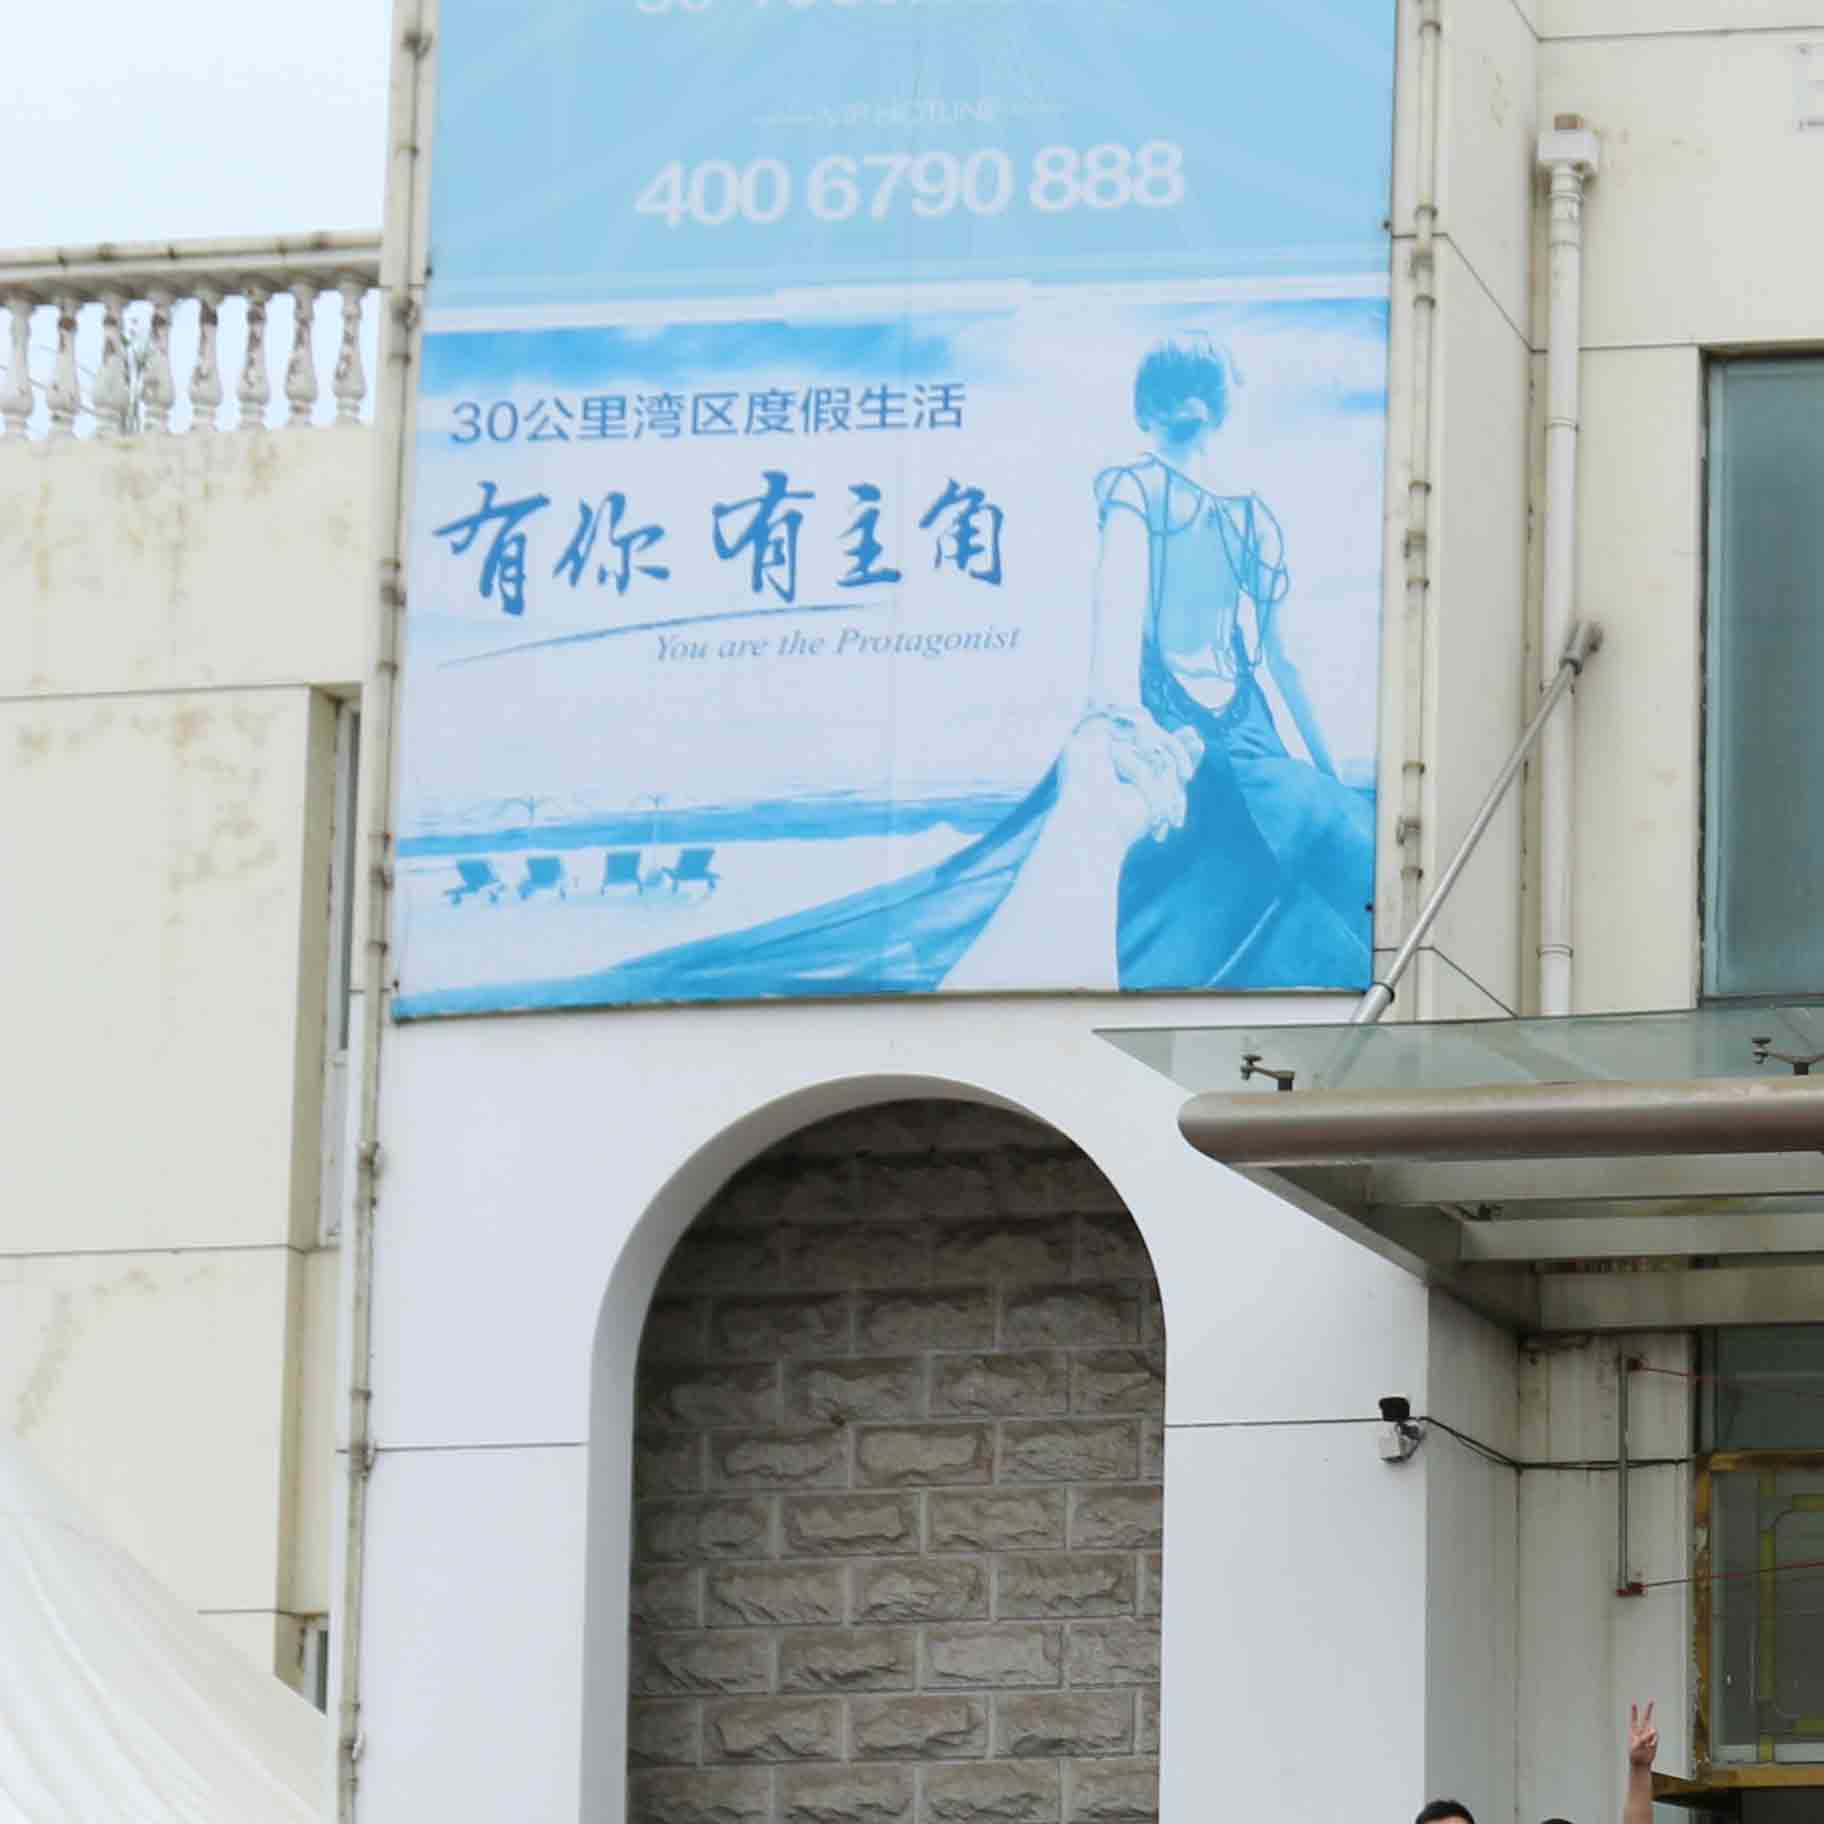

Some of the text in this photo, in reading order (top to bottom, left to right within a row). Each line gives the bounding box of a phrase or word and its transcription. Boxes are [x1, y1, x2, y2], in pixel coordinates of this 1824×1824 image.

[634, 140, 1187, 230] 400 6790 888
[449, 382, 965, 445] 30公里湾区度假生活
[655, 624, 1022, 662] You are the Protagonist
